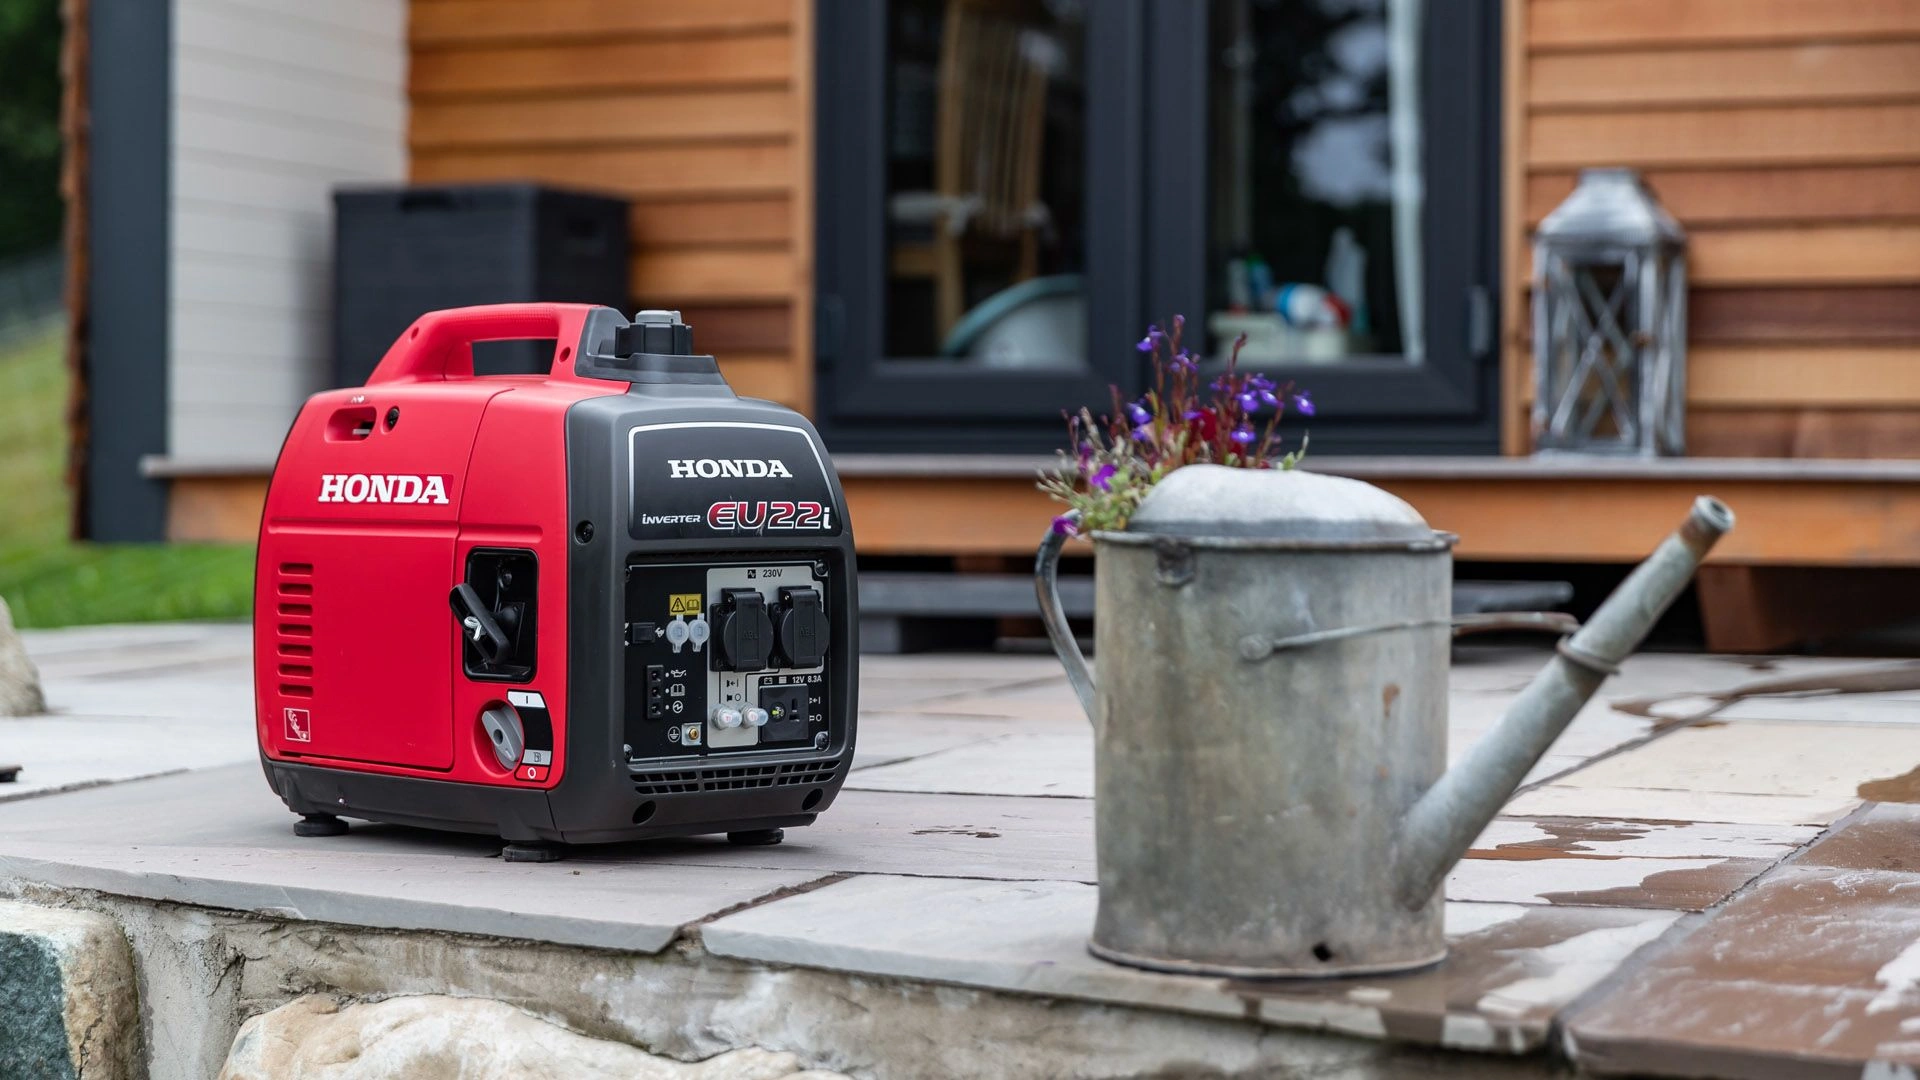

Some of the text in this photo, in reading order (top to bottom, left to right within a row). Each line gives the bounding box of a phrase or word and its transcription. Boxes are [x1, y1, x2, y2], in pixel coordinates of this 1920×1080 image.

[668, 459, 793, 478] HONDA
[318, 474, 449, 504] HONDA
[706, 501, 831, 530] EU22i
[763, 569, 783, 578] 230V
[807, 675, 822, 683] 8.3A
